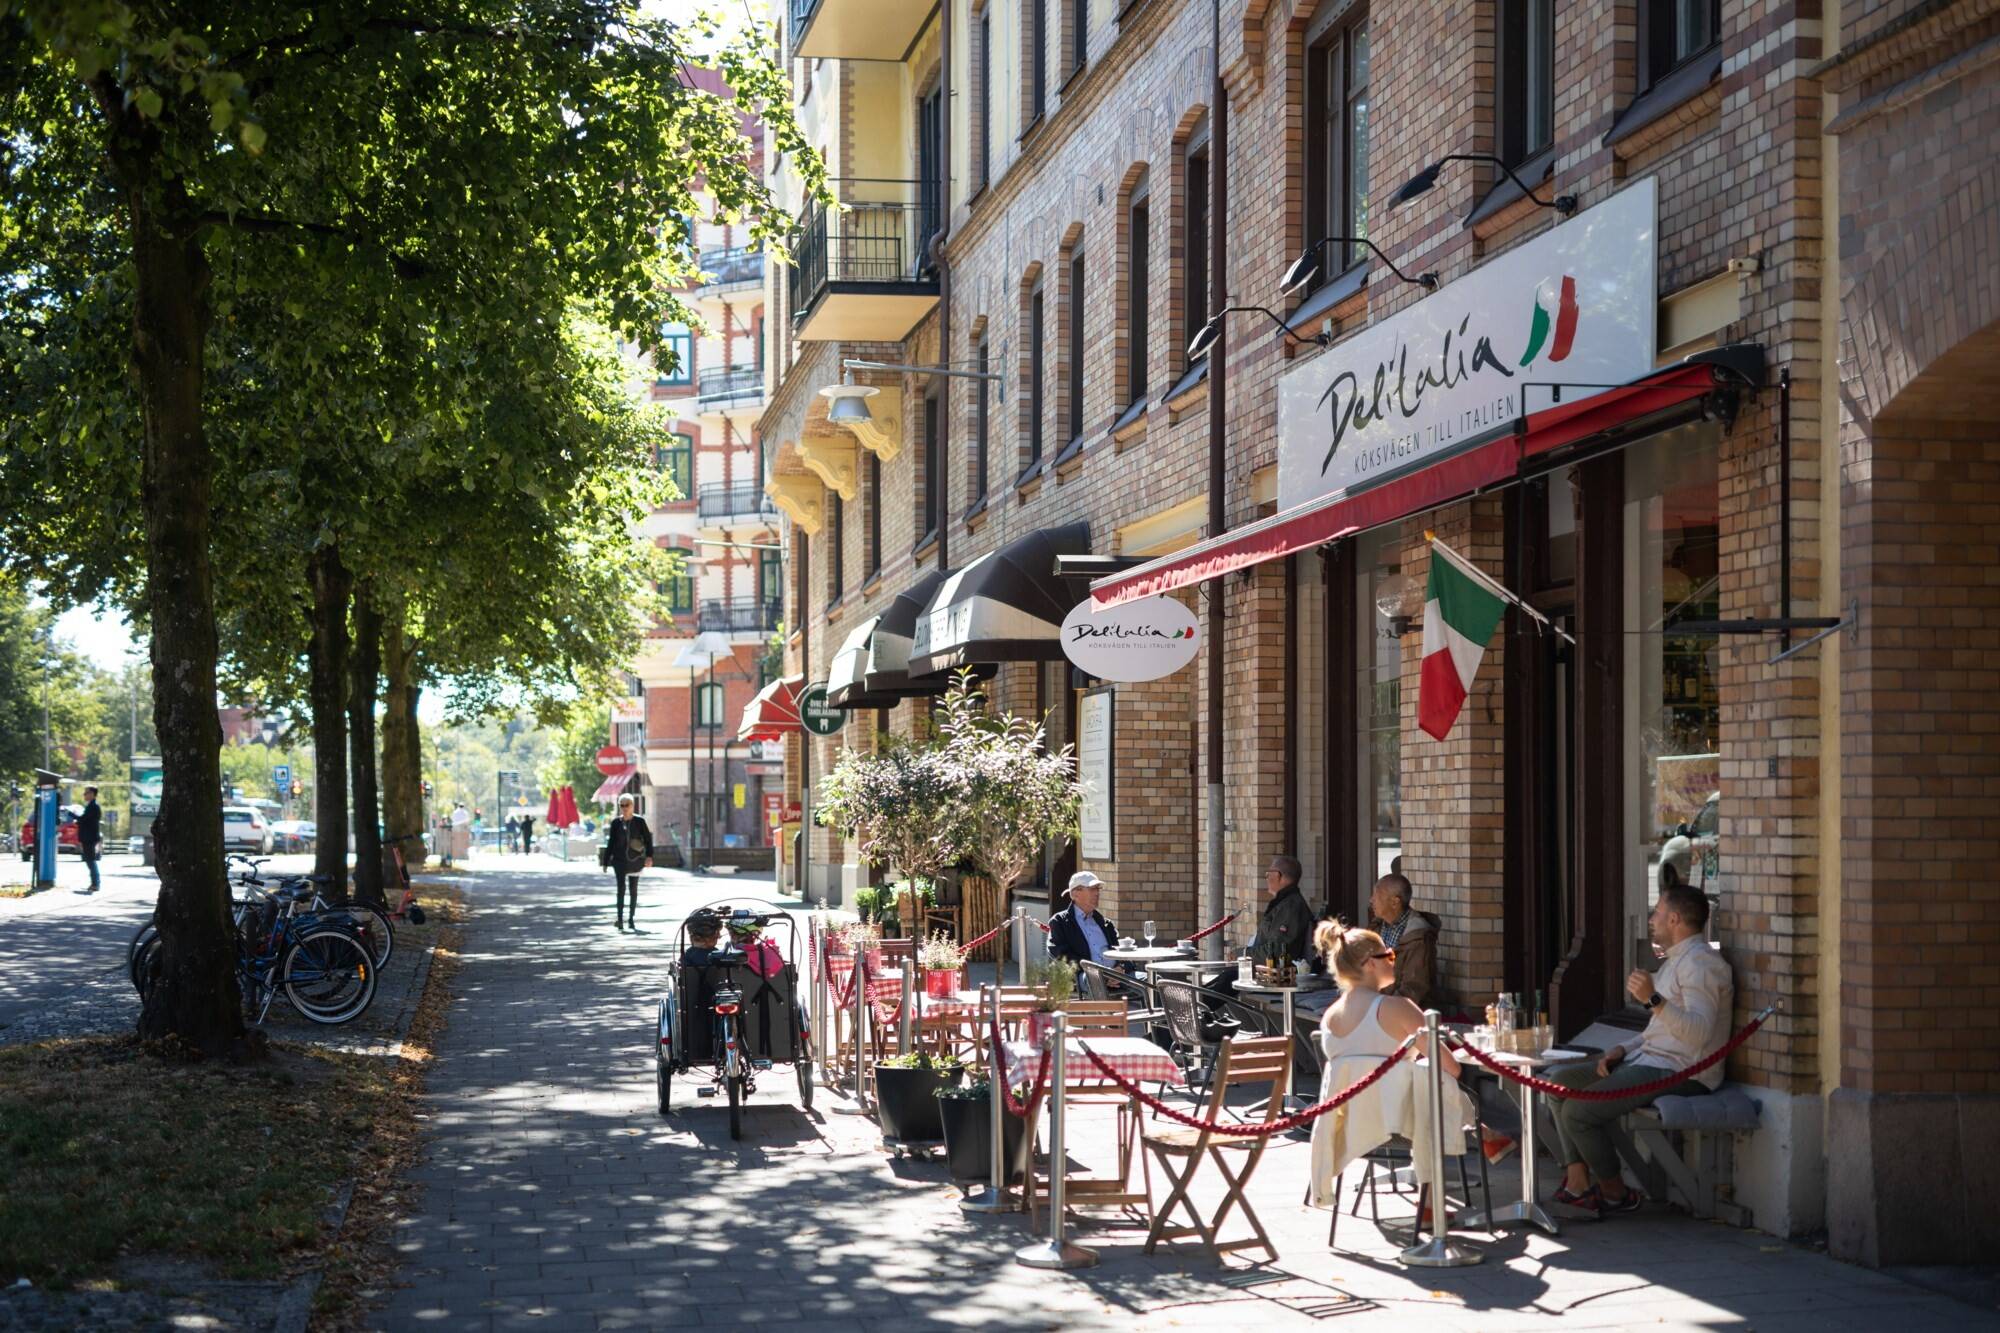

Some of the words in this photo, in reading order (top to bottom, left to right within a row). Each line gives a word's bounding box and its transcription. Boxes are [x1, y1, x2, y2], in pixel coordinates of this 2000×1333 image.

[1354, 431, 1420, 474] KÖKSVÄGEN
[1427, 423, 1453, 446] TILL
[1460, 394, 1514, 433] ITALIEN
